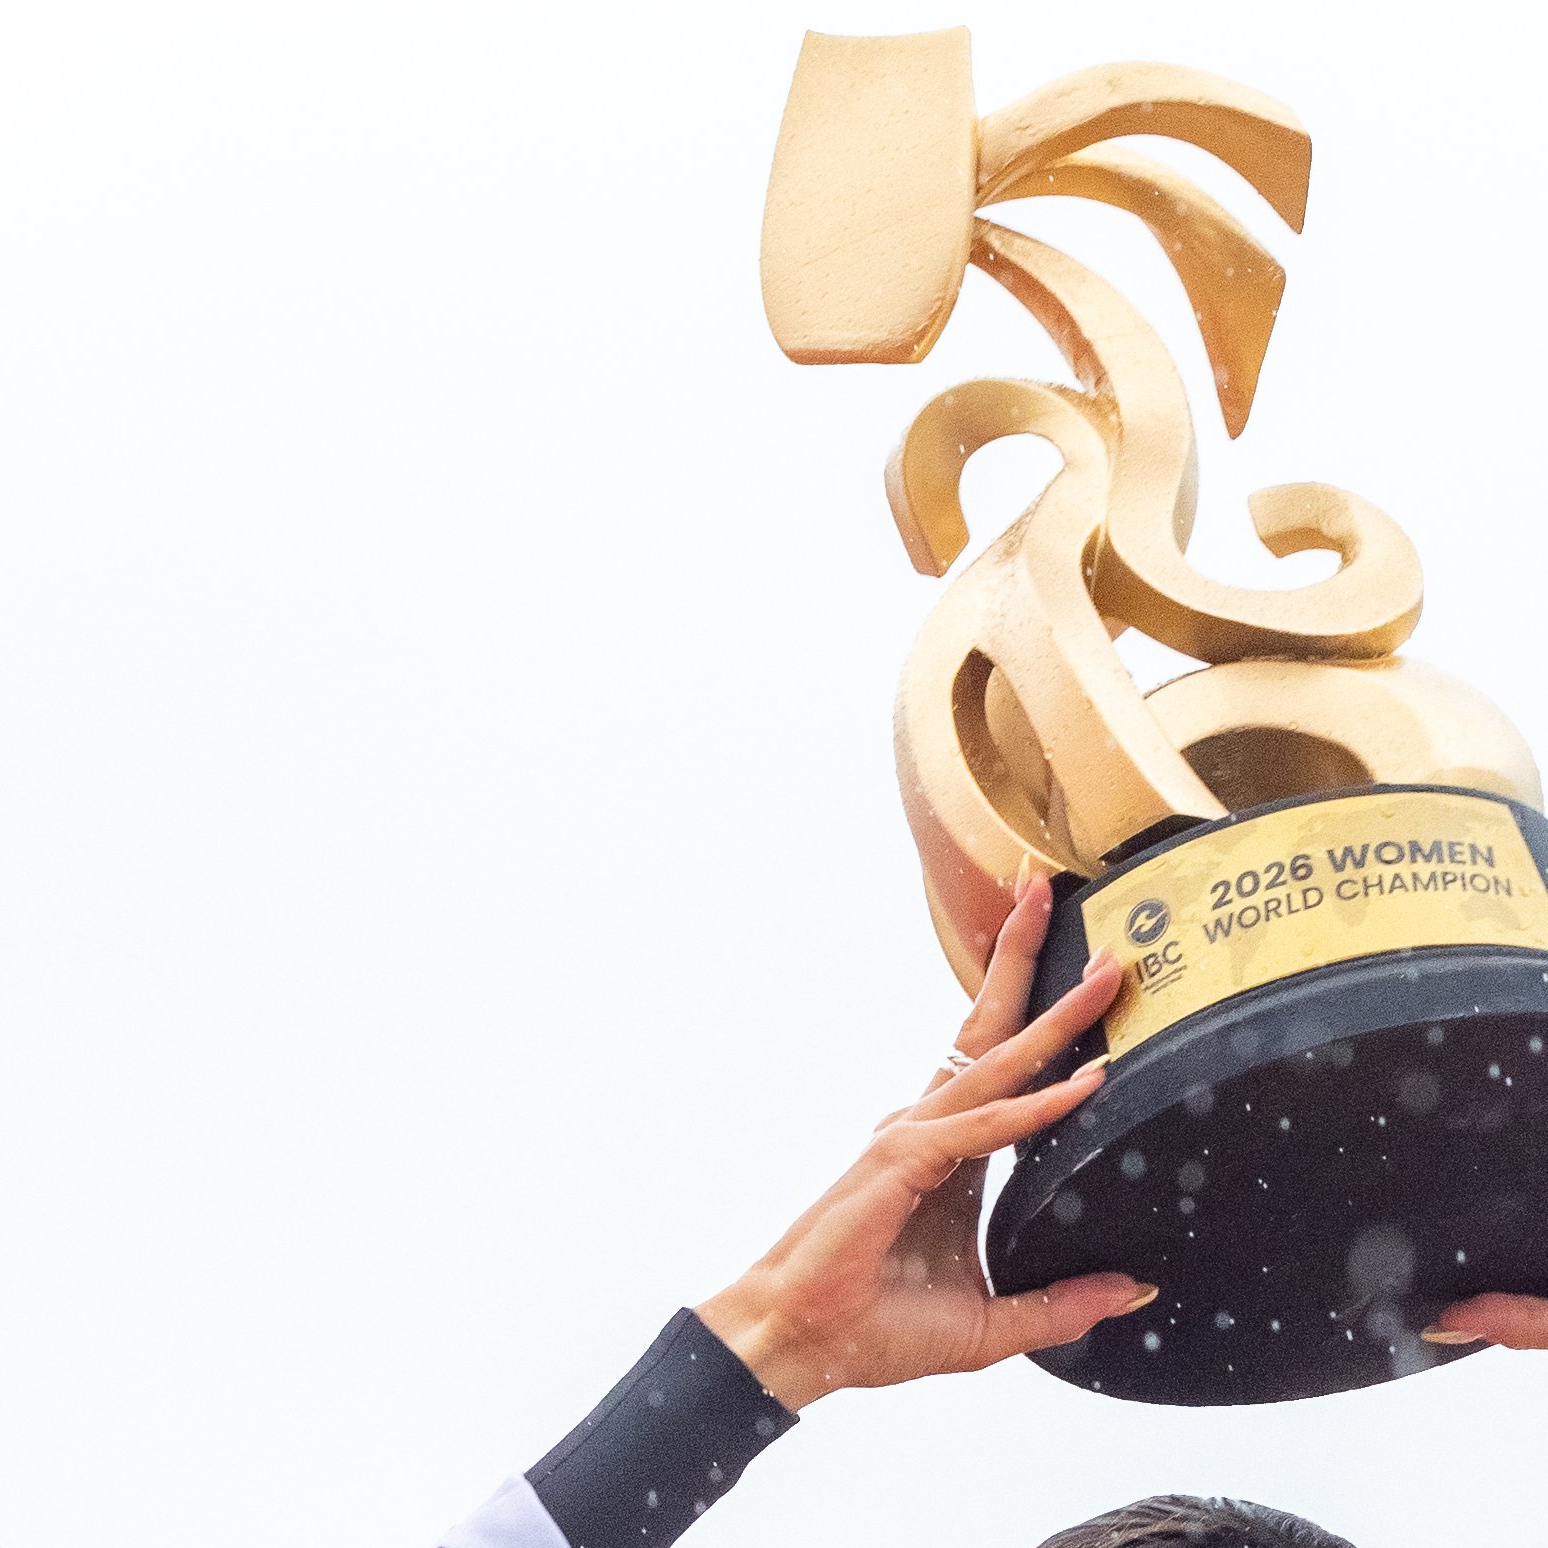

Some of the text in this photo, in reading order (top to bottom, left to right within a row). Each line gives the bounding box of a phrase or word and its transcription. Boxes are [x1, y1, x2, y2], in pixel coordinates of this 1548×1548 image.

[1202, 867, 1514, 946] WORLD CHAMPION
[1210, 839, 1496, 910] 2026 WOMEN
[1135, 940, 1183, 984] IBC
